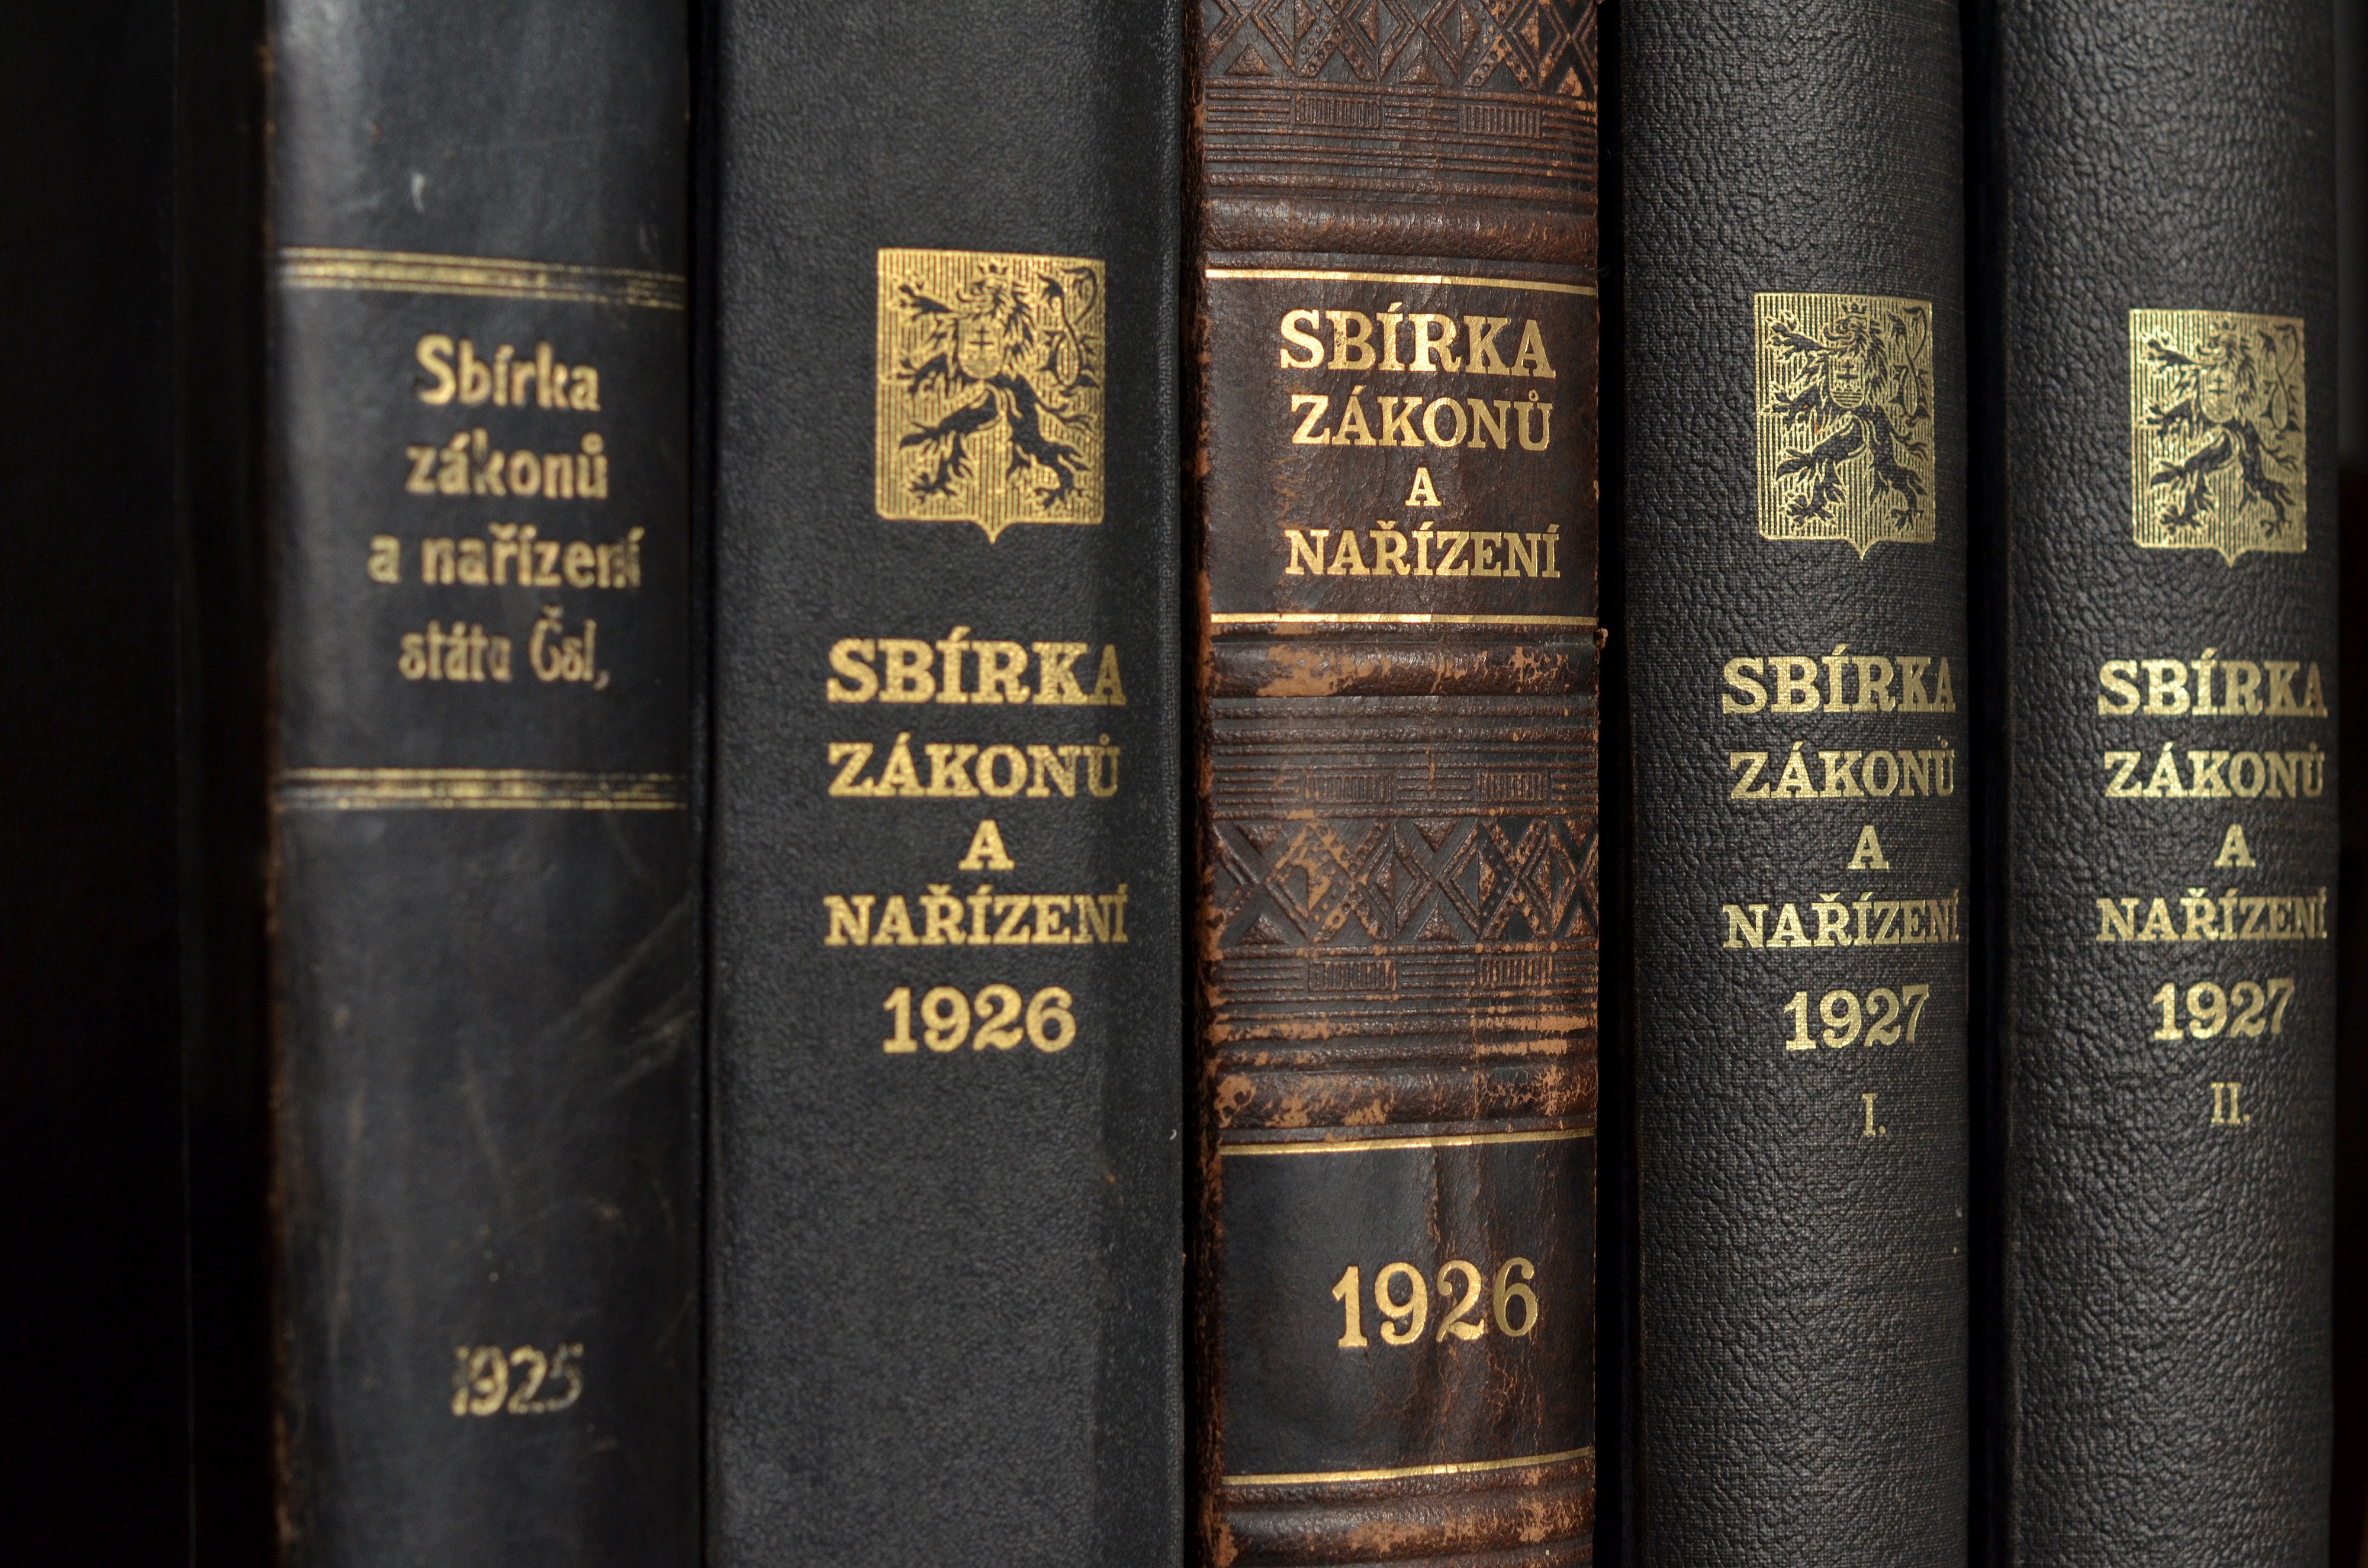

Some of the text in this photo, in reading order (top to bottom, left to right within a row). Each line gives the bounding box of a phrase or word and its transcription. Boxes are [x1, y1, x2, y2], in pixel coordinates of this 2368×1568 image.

[1280, 302, 1556, 378] SBÍRKA
[414, 332, 601, 411] Sbírka
[1291, 386, 1552, 450] ZÁKONŮ
[405, 427, 608, 498] zákonů
[1405, 467, 1442, 507] A
[367, 523, 645, 588] a nařízení
[1284, 520, 1559, 578] NAŘÍZENÍ
[398, 620, 511, 681] státu
[826, 626, 1126, 705] SBÍRKA
[1722, 643, 1955, 714] SBÍRKA
[2098, 648, 2327, 717] SBÍRKA
[829, 732, 1120, 797] ZÁKONŮ
[1729, 738, 1954, 799] ZÁKONŮ
[2104, 743, 2325, 798] ZÁKONŮ
[958, 819, 1015, 870] A
[1848, 825, 1889, 870] A
[2214, 824, 2255, 867] A
[823, 884, 1128, 945] NAŘÍZENÍ
[1722, 890, 1959, 948] NAŘÍZENÍ
[2096, 887, 2327, 942] NAŘÍZENÍ
[883, 984, 1076, 1053] 1926
[1783, 984, 1929, 1050] 1927
[2152, 978, 2295, 1040] 1927
[1862, 1093, 1886, 1136] I.
[2210, 1082, 2250, 1125] II.
[1331, 1257, 1537, 1348] 1926
[452, 1344, 584, 1416] 1925
